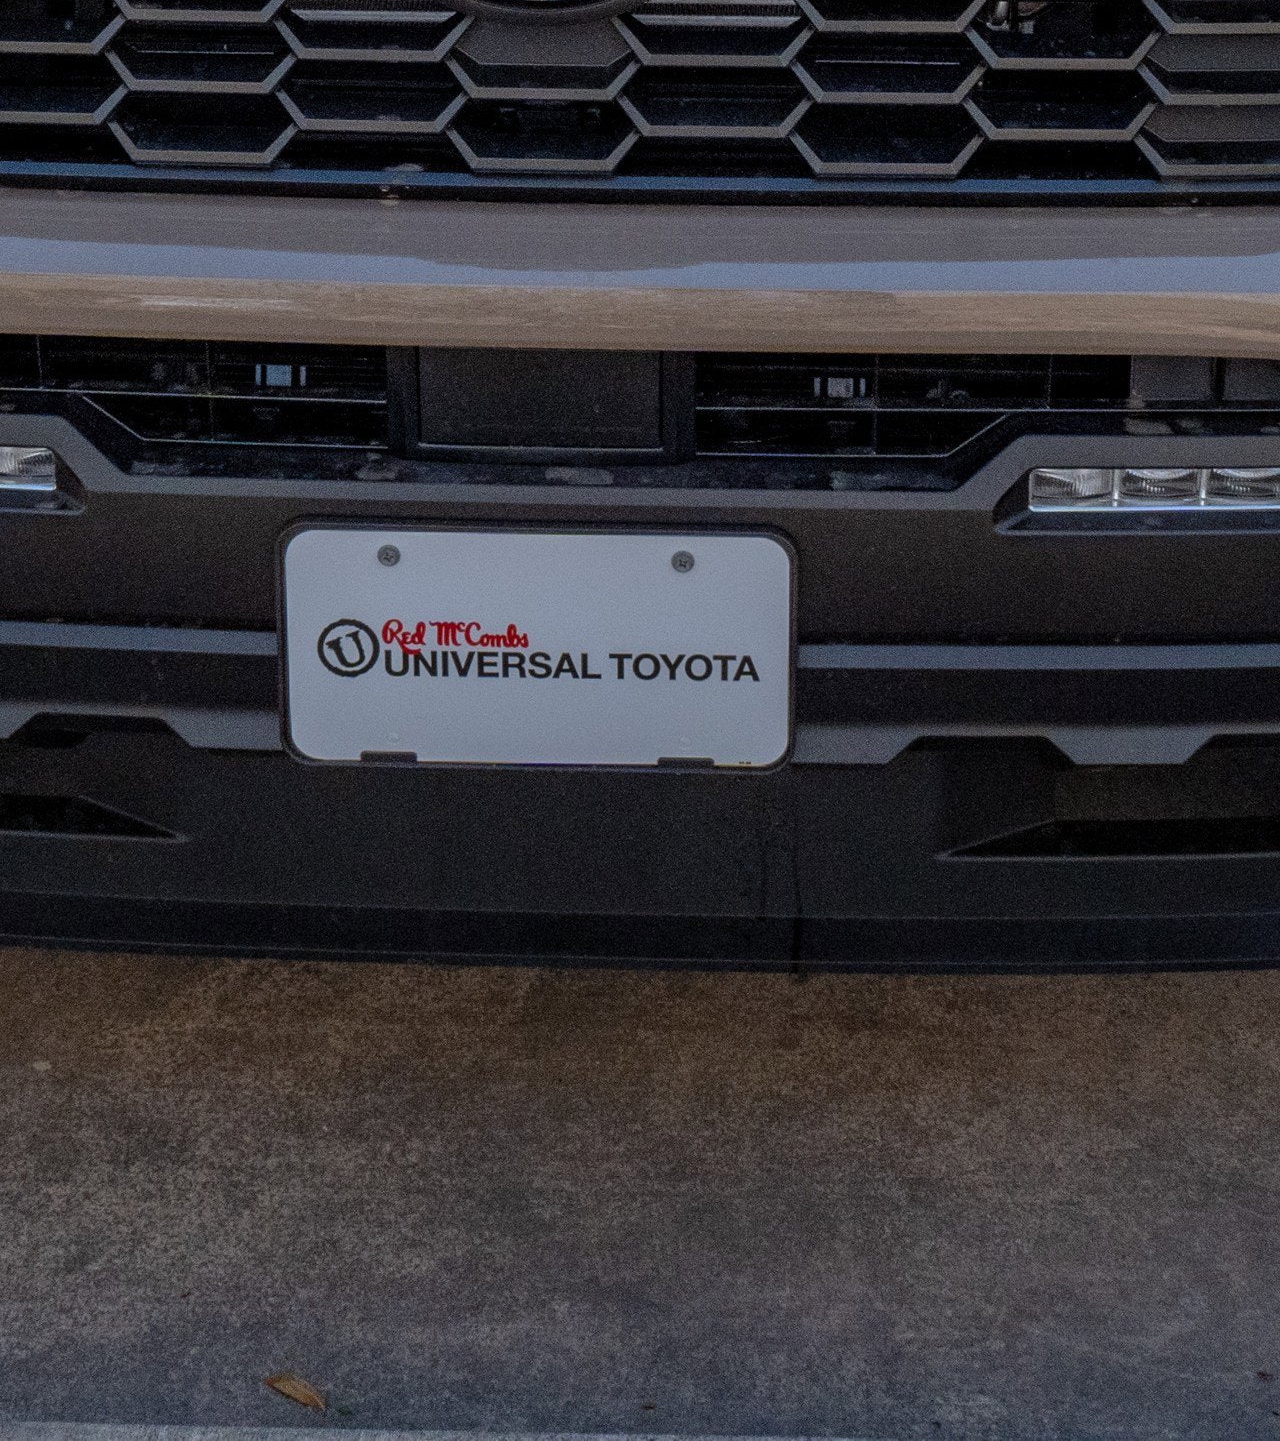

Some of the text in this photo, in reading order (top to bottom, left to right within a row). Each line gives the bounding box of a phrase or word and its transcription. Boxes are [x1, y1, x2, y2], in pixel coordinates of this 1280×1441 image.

[381, 618, 529, 655] Red McCombs
[384, 649, 760, 682] UNIVERSAL TOYOTA
